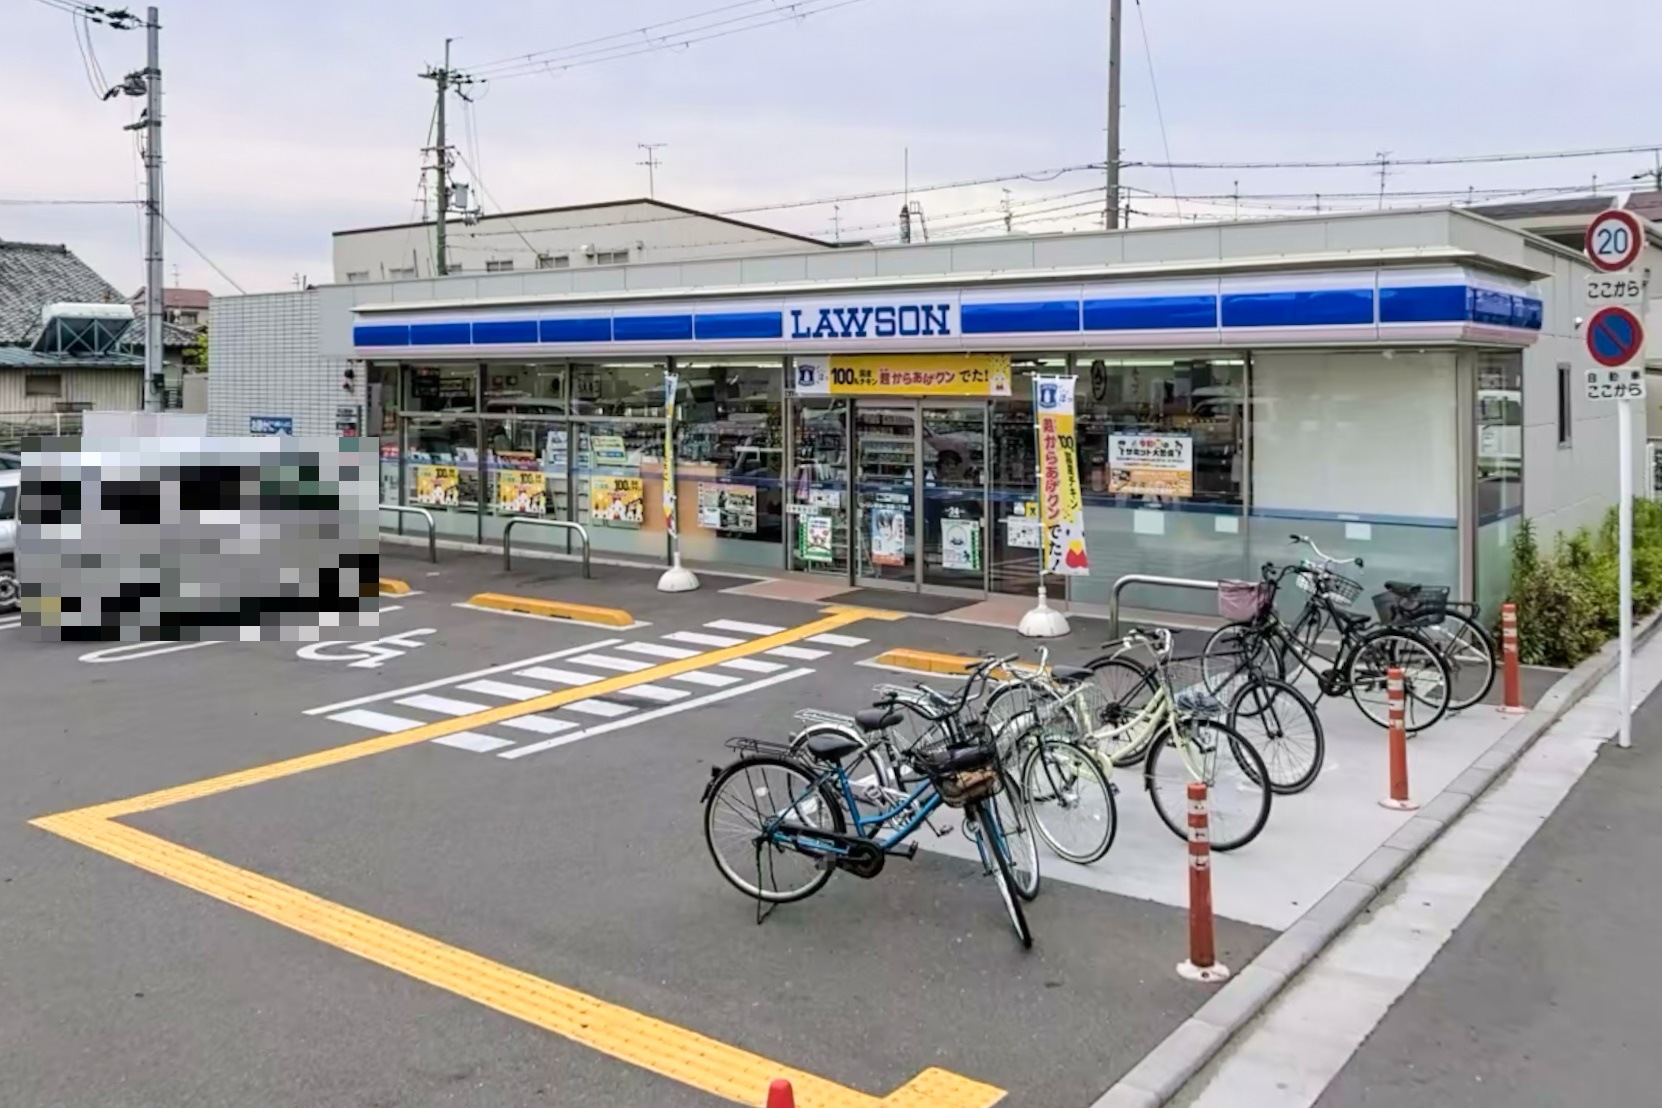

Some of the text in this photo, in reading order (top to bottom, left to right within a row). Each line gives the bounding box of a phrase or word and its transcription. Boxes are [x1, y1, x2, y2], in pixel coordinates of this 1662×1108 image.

[1597, 227, 1629, 255] 20
[1587, 280, 1640, 299] ここから
[790, 304, 951, 339] LAWSON
[1587, 383, 1642, 398] ここから
